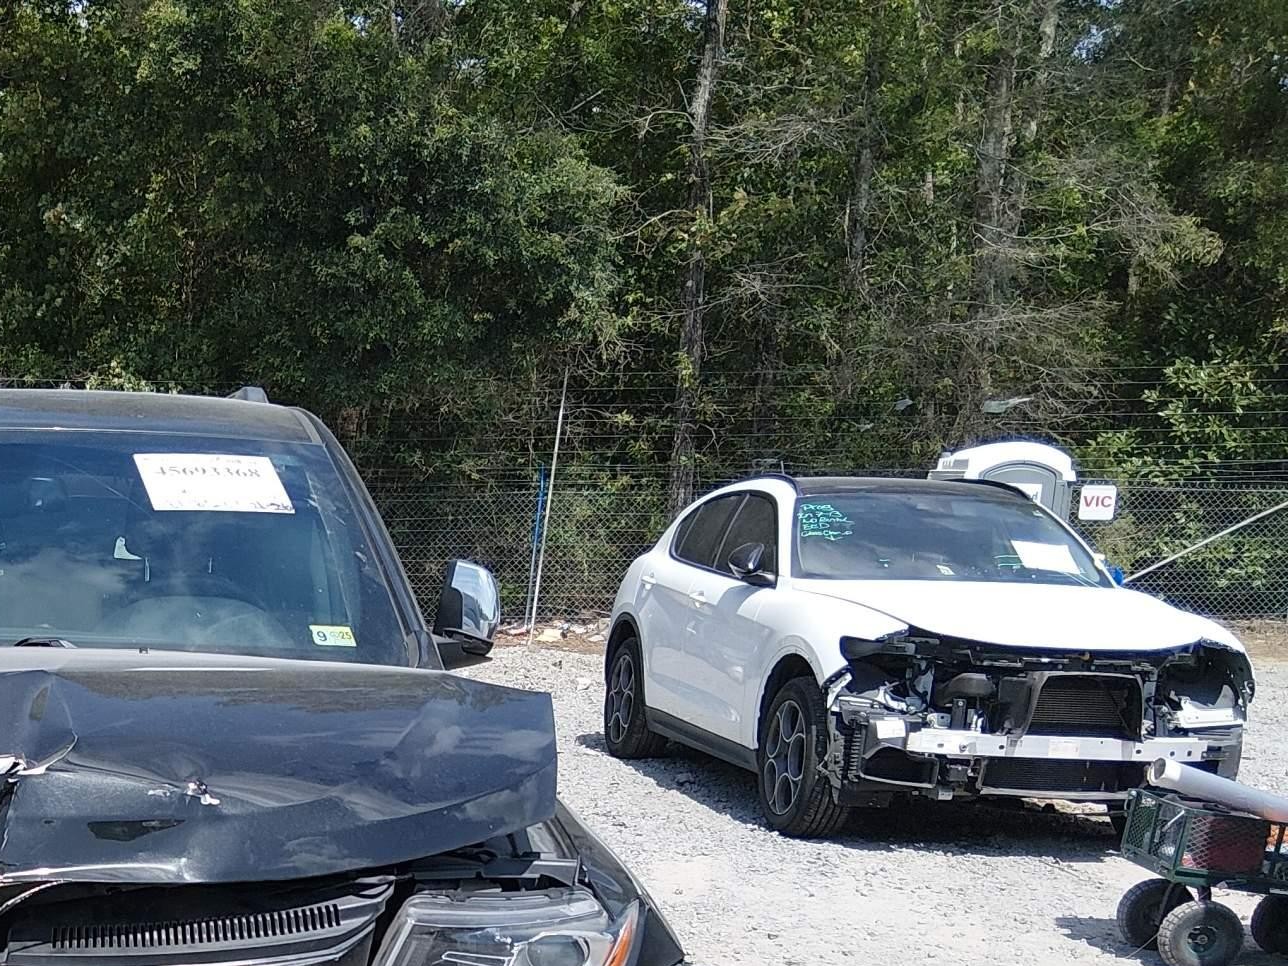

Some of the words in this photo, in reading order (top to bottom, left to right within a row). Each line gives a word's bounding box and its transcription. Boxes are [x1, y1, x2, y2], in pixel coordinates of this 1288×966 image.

[1083, 495, 1113, 508] VIC
[316, 630, 328, 642] 9
[339, 631, 353, 640] 25
